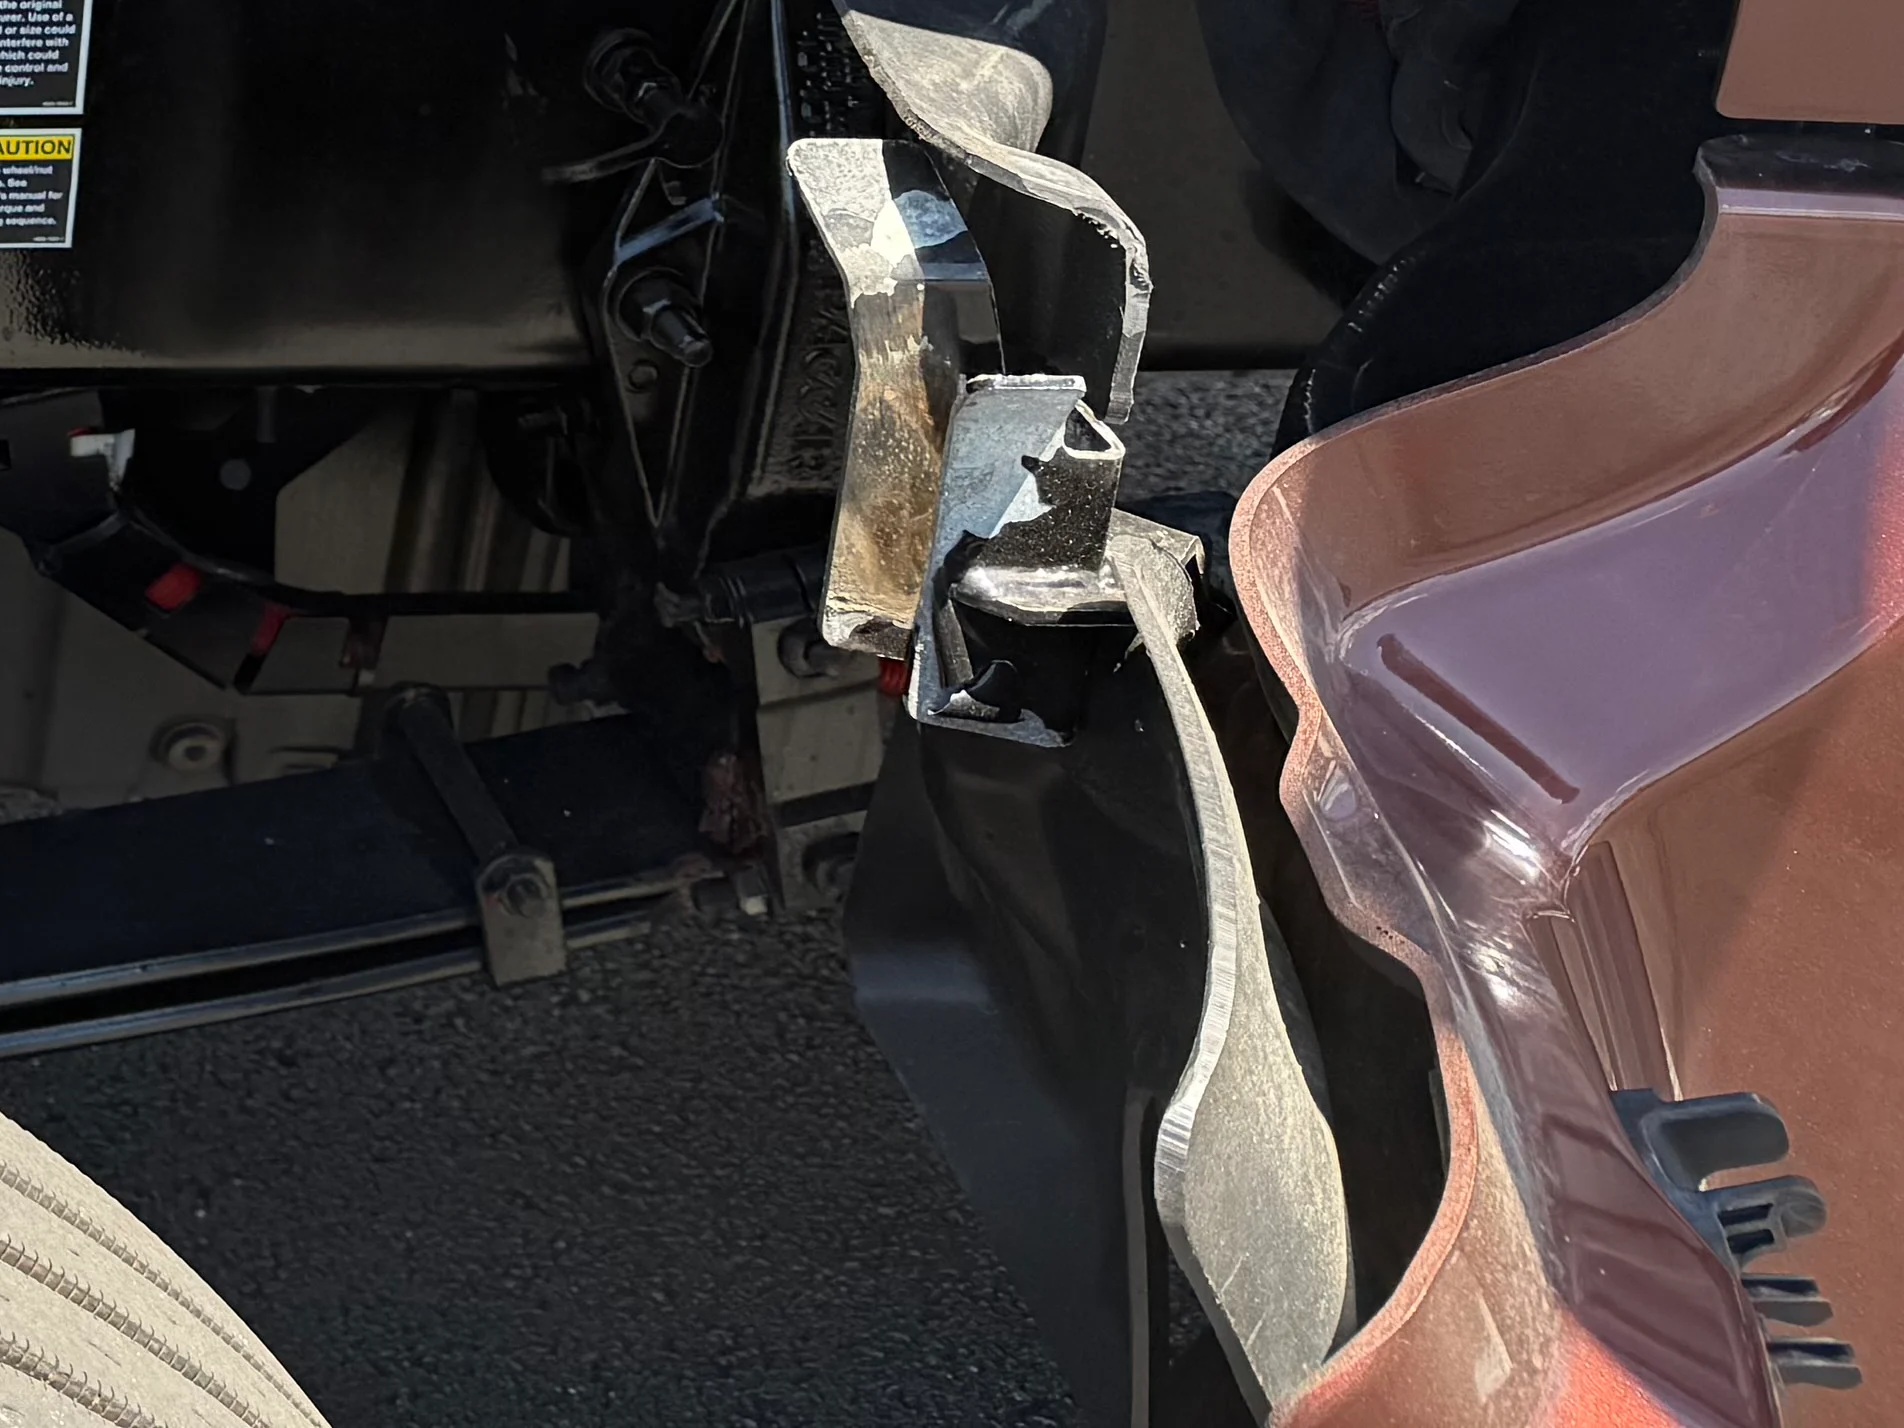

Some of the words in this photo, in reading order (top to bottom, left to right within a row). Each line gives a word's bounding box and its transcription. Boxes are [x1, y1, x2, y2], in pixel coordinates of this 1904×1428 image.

[0, 0, 17, 9] the
[19, 0, 62, 10] original
[28, 12, 49, 21] Use
[52, 12, 63, 21] of
[65, 13, 73, 21] a
[4, 26, 16, 34] or
[19, 26, 41, 34] size
[44, 25, 75, 34] could
[45, 38, 68, 46] with
[27, 51, 59, 59] could
[4, 64, 44, 72] control
[47, 63, 68, 71] and
